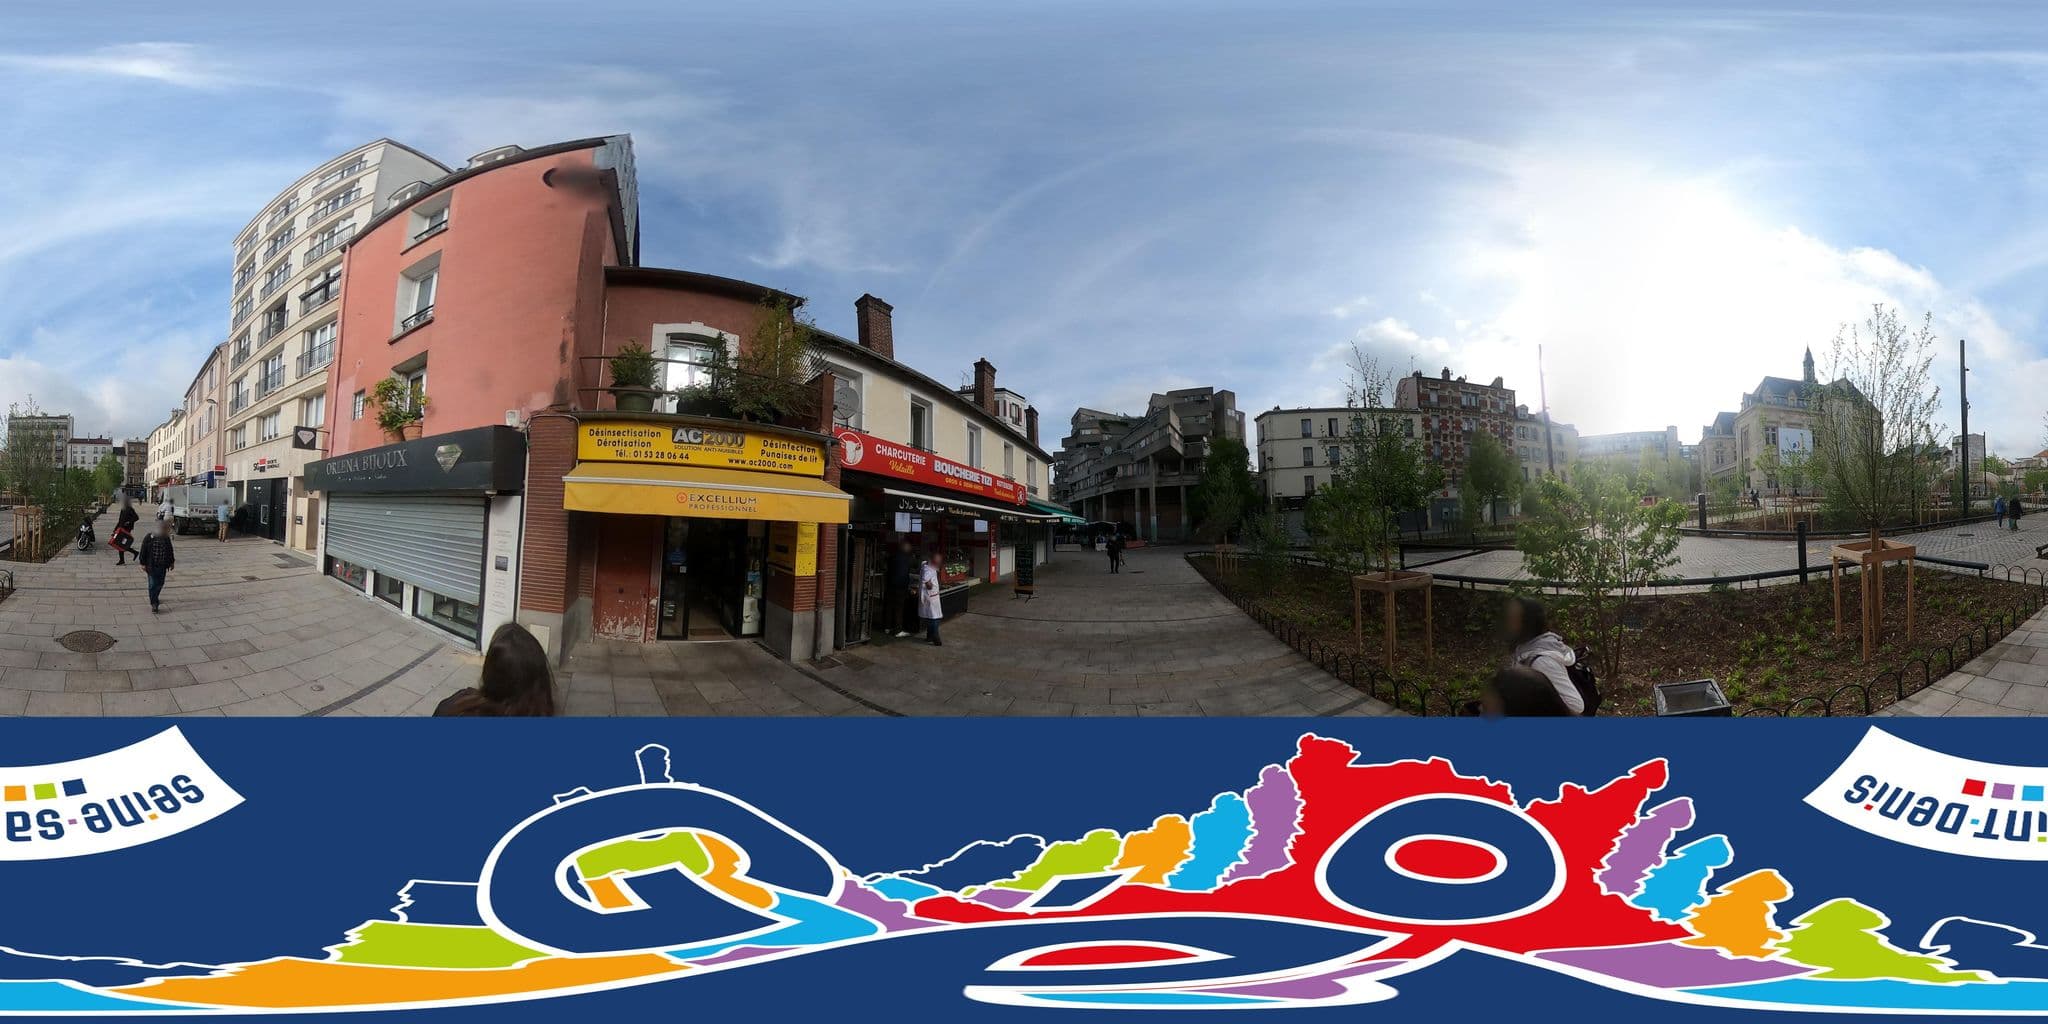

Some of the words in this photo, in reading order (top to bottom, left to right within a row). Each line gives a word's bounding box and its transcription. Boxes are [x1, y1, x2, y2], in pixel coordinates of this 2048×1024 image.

[589, 428, 661, 438] Désinsectisation
[673, 428, 745, 448] AC2000
[597, 438, 652, 448] Dératisation
[763, 440, 816, 453] Désinfection
[633, 450, 642, 458] 01
[643, 451, 653, 459] 53
[654, 451, 665, 459] 28
[666, 452, 677, 460] 06
[678, 452, 689, 461] 44
[760, 449, 797, 461] Punaises
[798, 453, 808, 462] de
[809, 454, 818, 463] lit
[875, 443, 926, 466] CHARCUTERIE
[326, 459, 359, 476] ORLENA
[362, 449, 408, 471] BIJOUX
[728, 457, 794, 470] www.ac2000.com
[934, 460, 980, 483] BOUCHERIE
[689, 493, 757, 504] EXCELLIUM
[688, 503, 757, 513] PROFESSIONNEL
